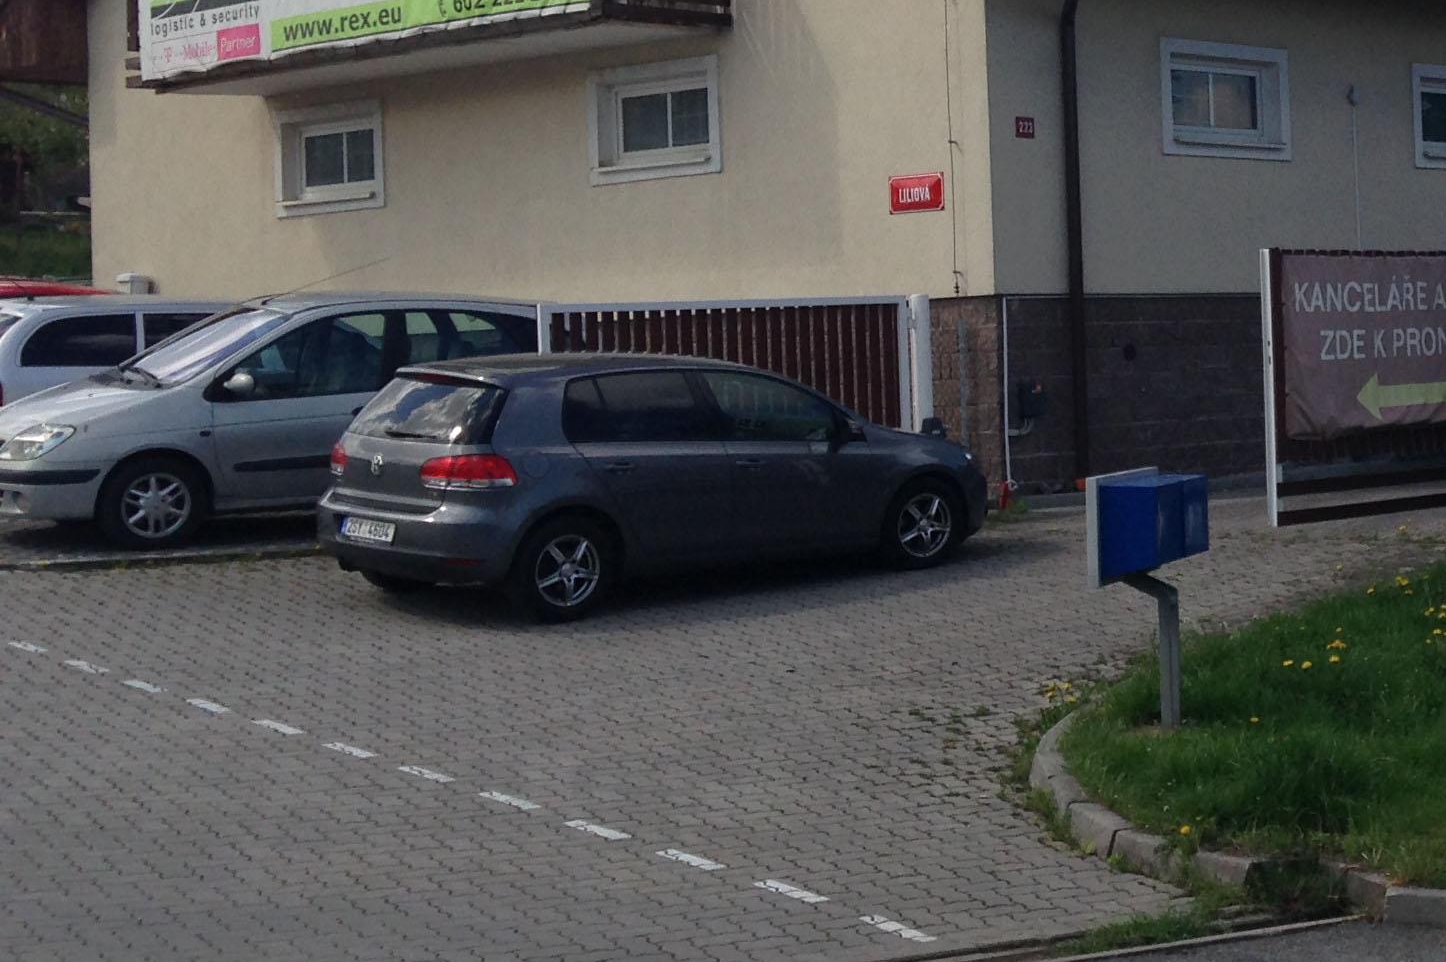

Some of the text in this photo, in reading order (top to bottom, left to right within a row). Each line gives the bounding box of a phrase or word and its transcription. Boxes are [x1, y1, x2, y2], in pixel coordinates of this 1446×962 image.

[151, 4, 260, 38] logistic & security
[283, 5, 402, 42] www.rex.eu
[220, 35, 256, 52] Partner
[898, 184, 931, 203] LILIOVÁ
[1294, 275, 1428, 313] KANCELÁŘE
[1320, 329, 1366, 361] ZDE
[1374, 329, 1387, 359] K
